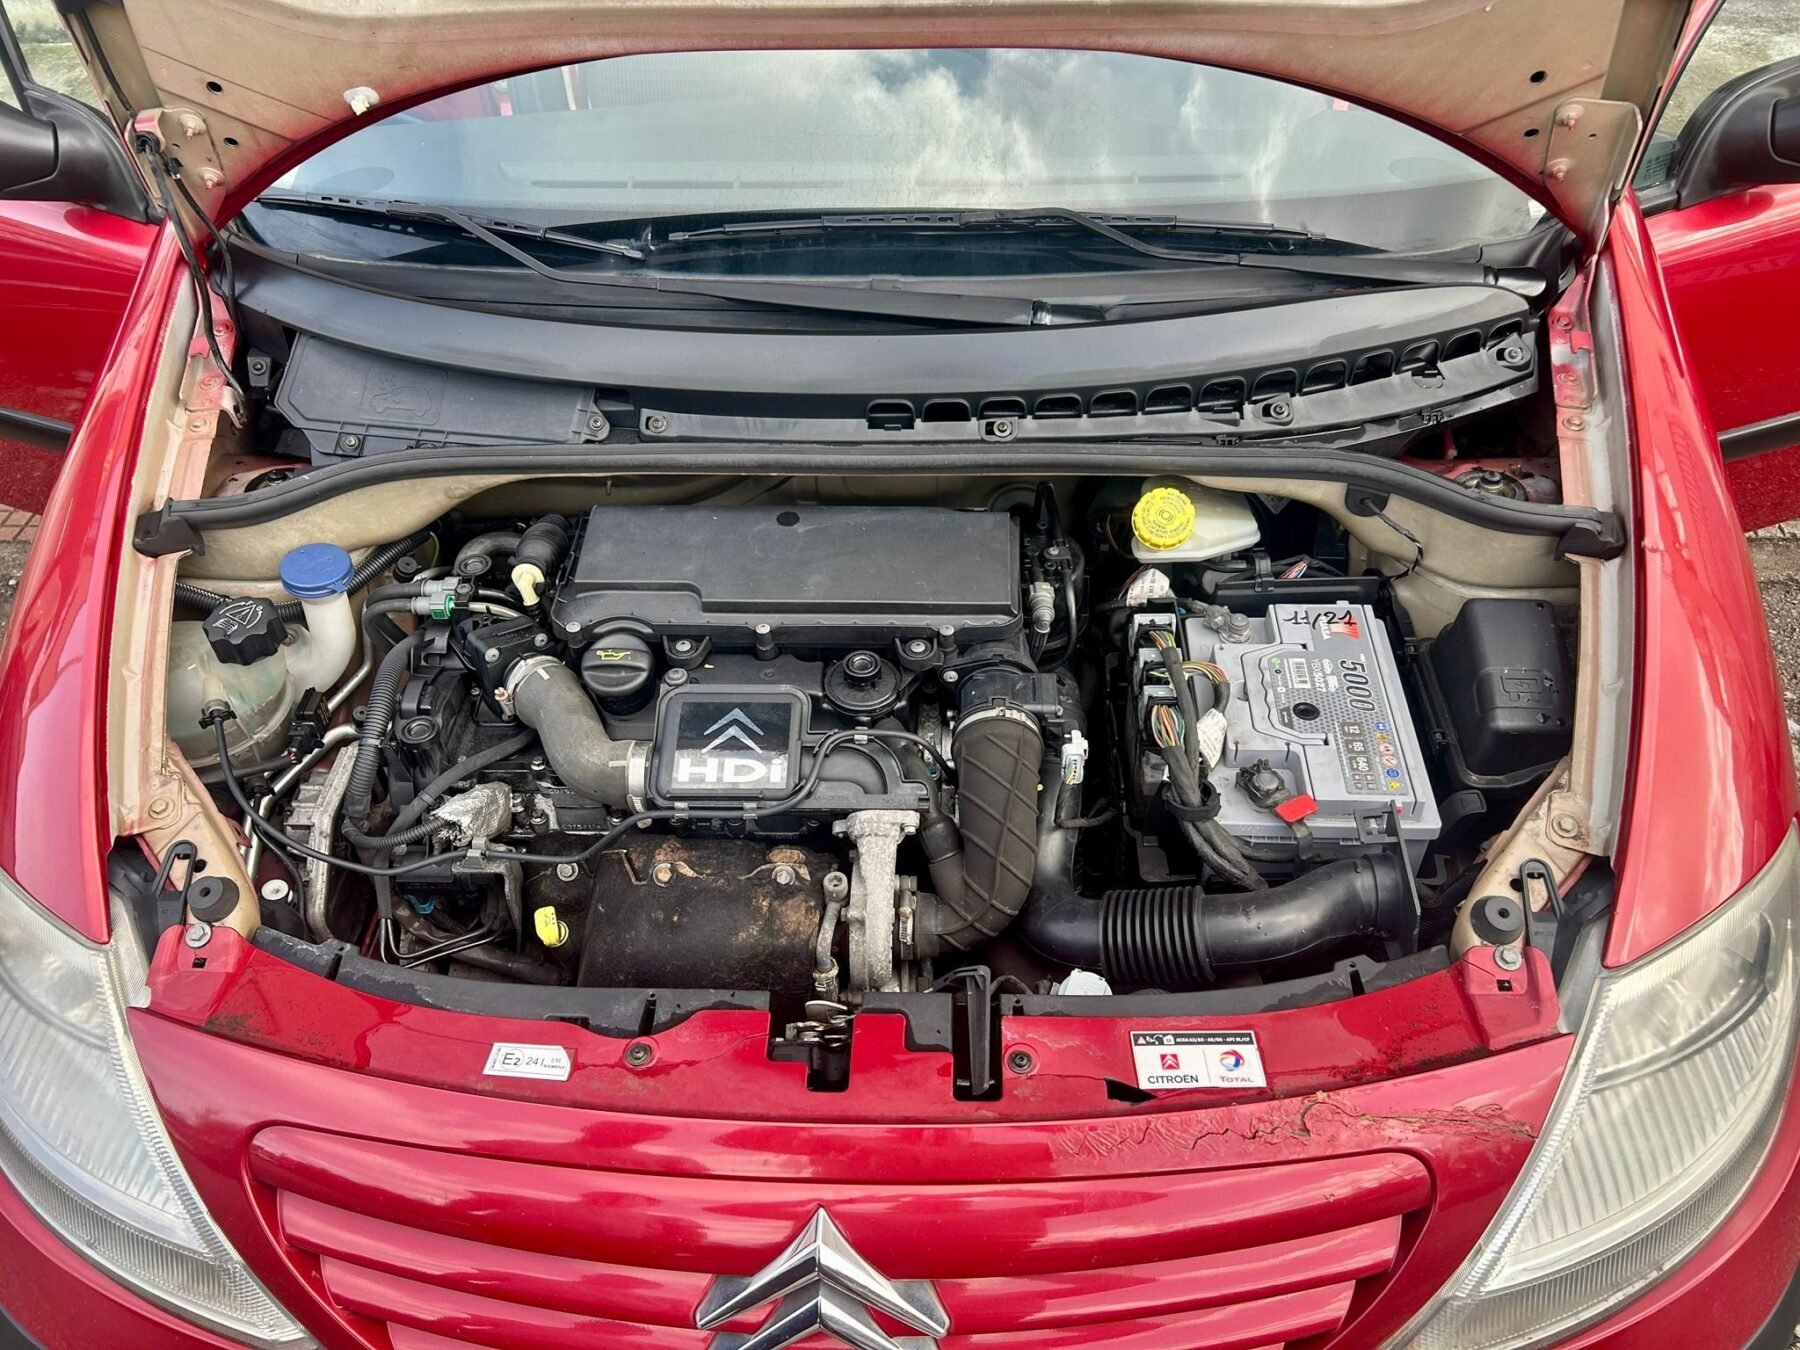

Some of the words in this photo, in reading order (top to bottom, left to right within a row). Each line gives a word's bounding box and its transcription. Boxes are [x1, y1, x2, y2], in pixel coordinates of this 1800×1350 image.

[1311, 658, 1327, 693] YBX5027
[1339, 659, 1377, 713] 5000
[1349, 725, 1360, 734] 12
[677, 758, 783, 783] HDi
[1356, 757, 1369, 771] 640
[502, 1052, 521, 1066] E2
[1147, 1074, 1199, 1084] CITROËN
